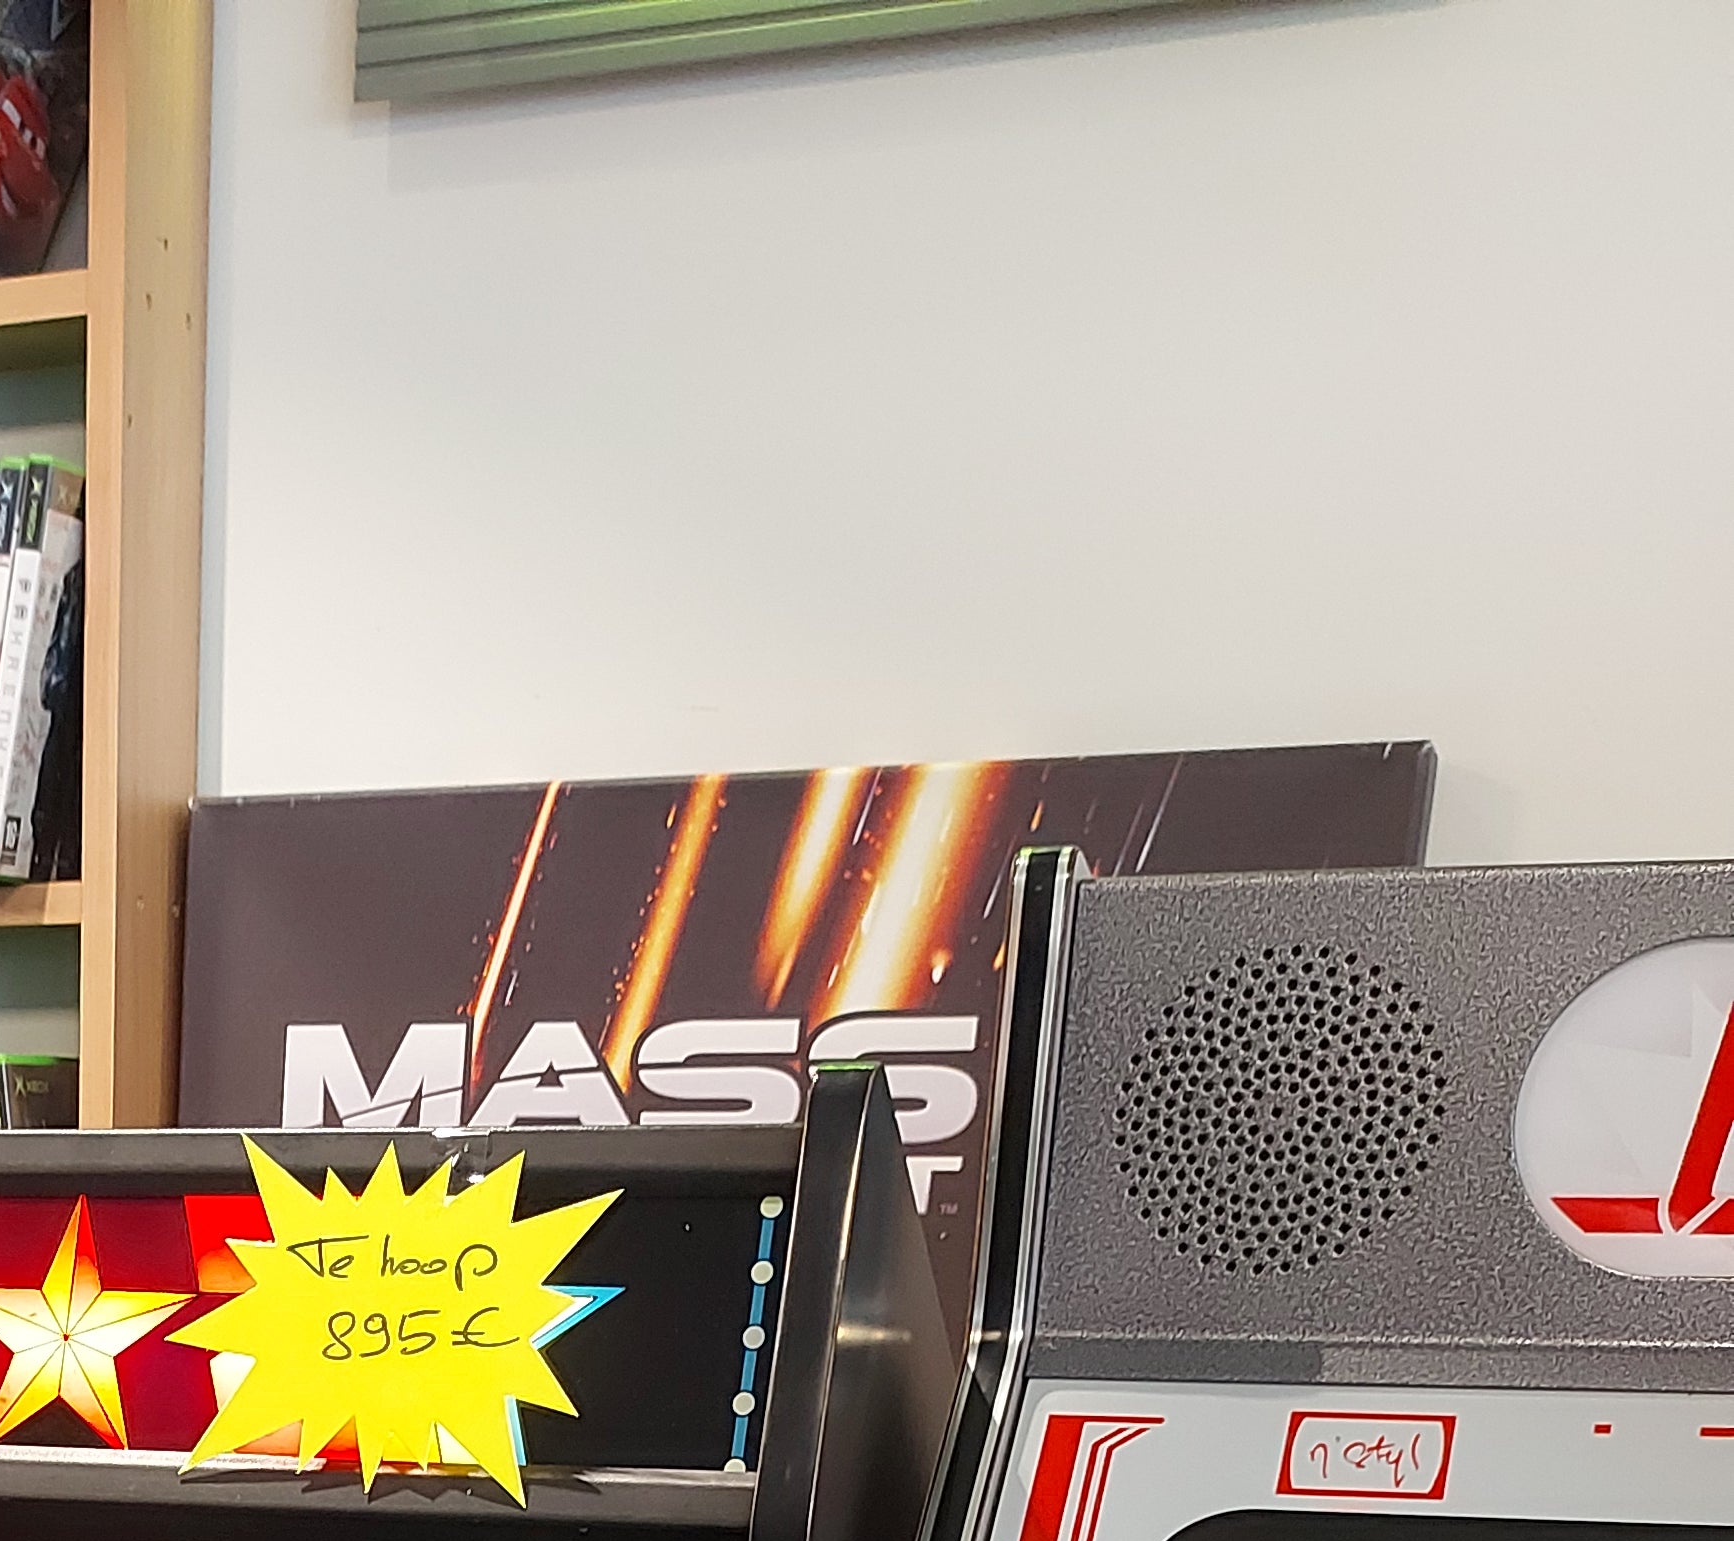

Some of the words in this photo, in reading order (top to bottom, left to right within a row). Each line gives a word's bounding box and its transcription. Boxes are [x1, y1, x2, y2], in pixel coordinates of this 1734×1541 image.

[281, 1016, 979, 1144] MASS
[286, 1235, 369, 1278] Te
[381, 1233, 498, 1291] hoop
